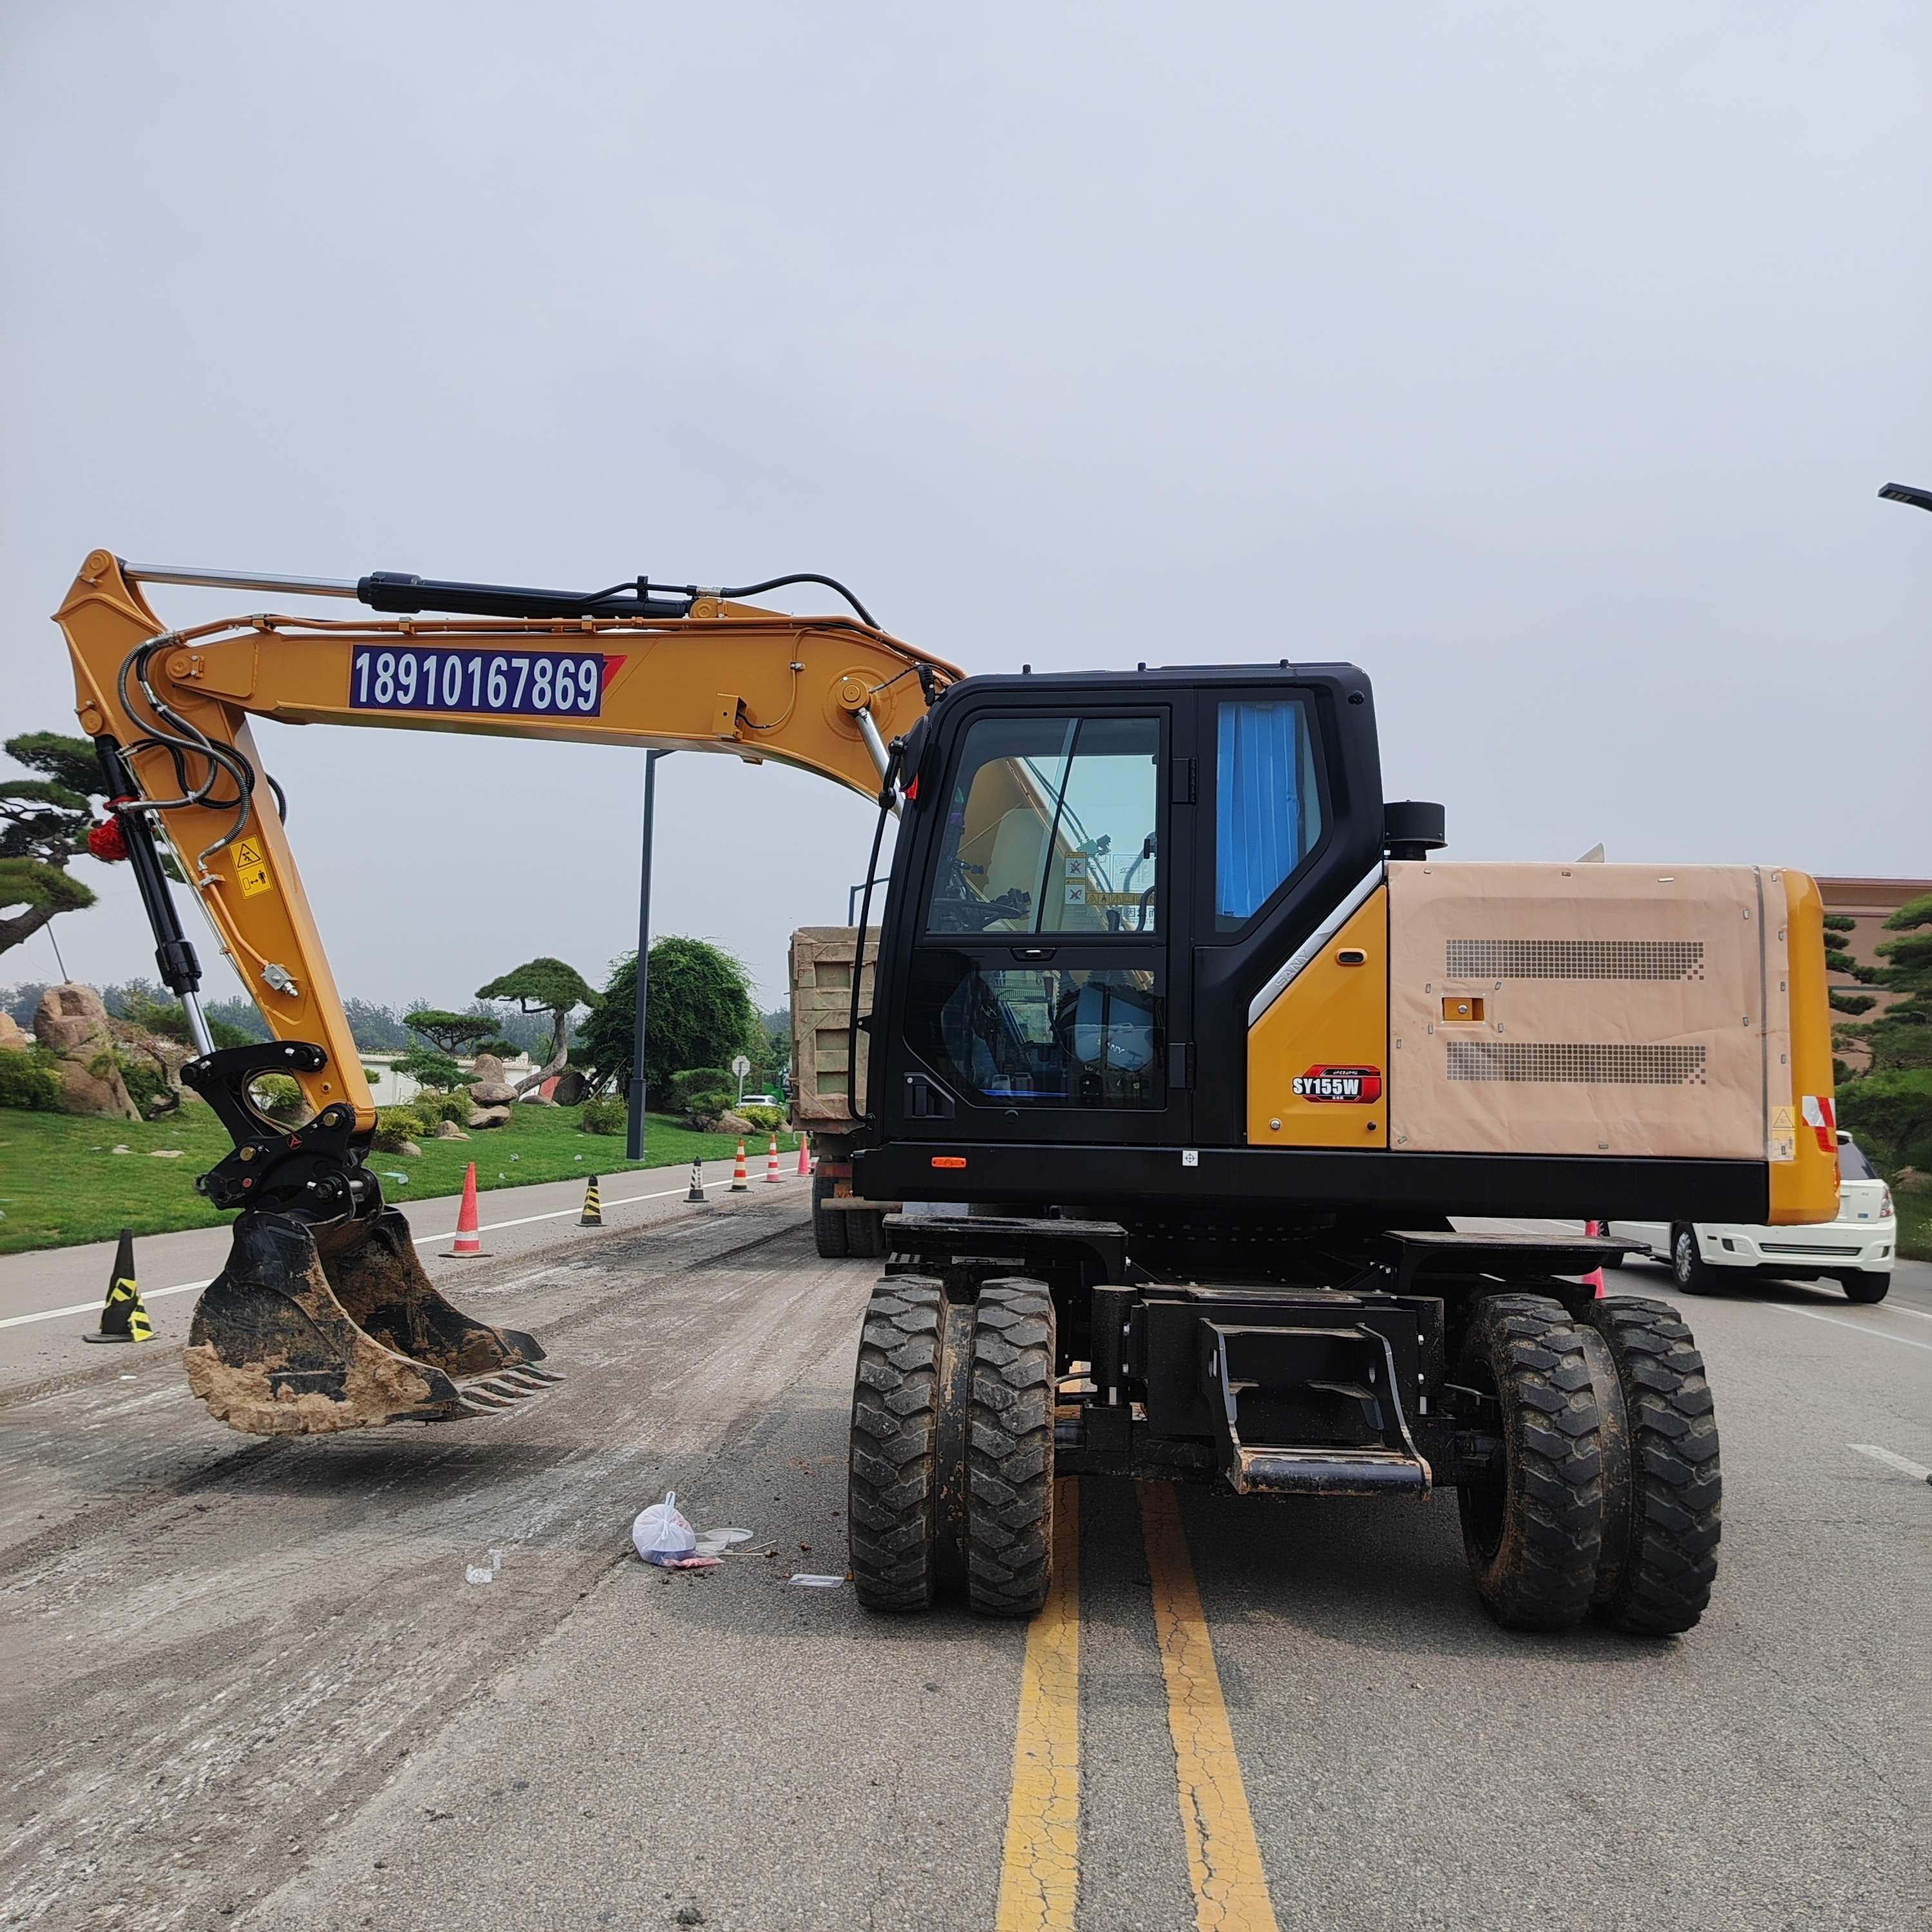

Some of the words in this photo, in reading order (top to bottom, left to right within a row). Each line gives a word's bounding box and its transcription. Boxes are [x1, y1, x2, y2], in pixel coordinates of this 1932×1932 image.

[355, 652, 598, 711] 18910167869
[1275, 949, 1309, 989] SANY
[1293, 1077, 1359, 1095] SY155W
